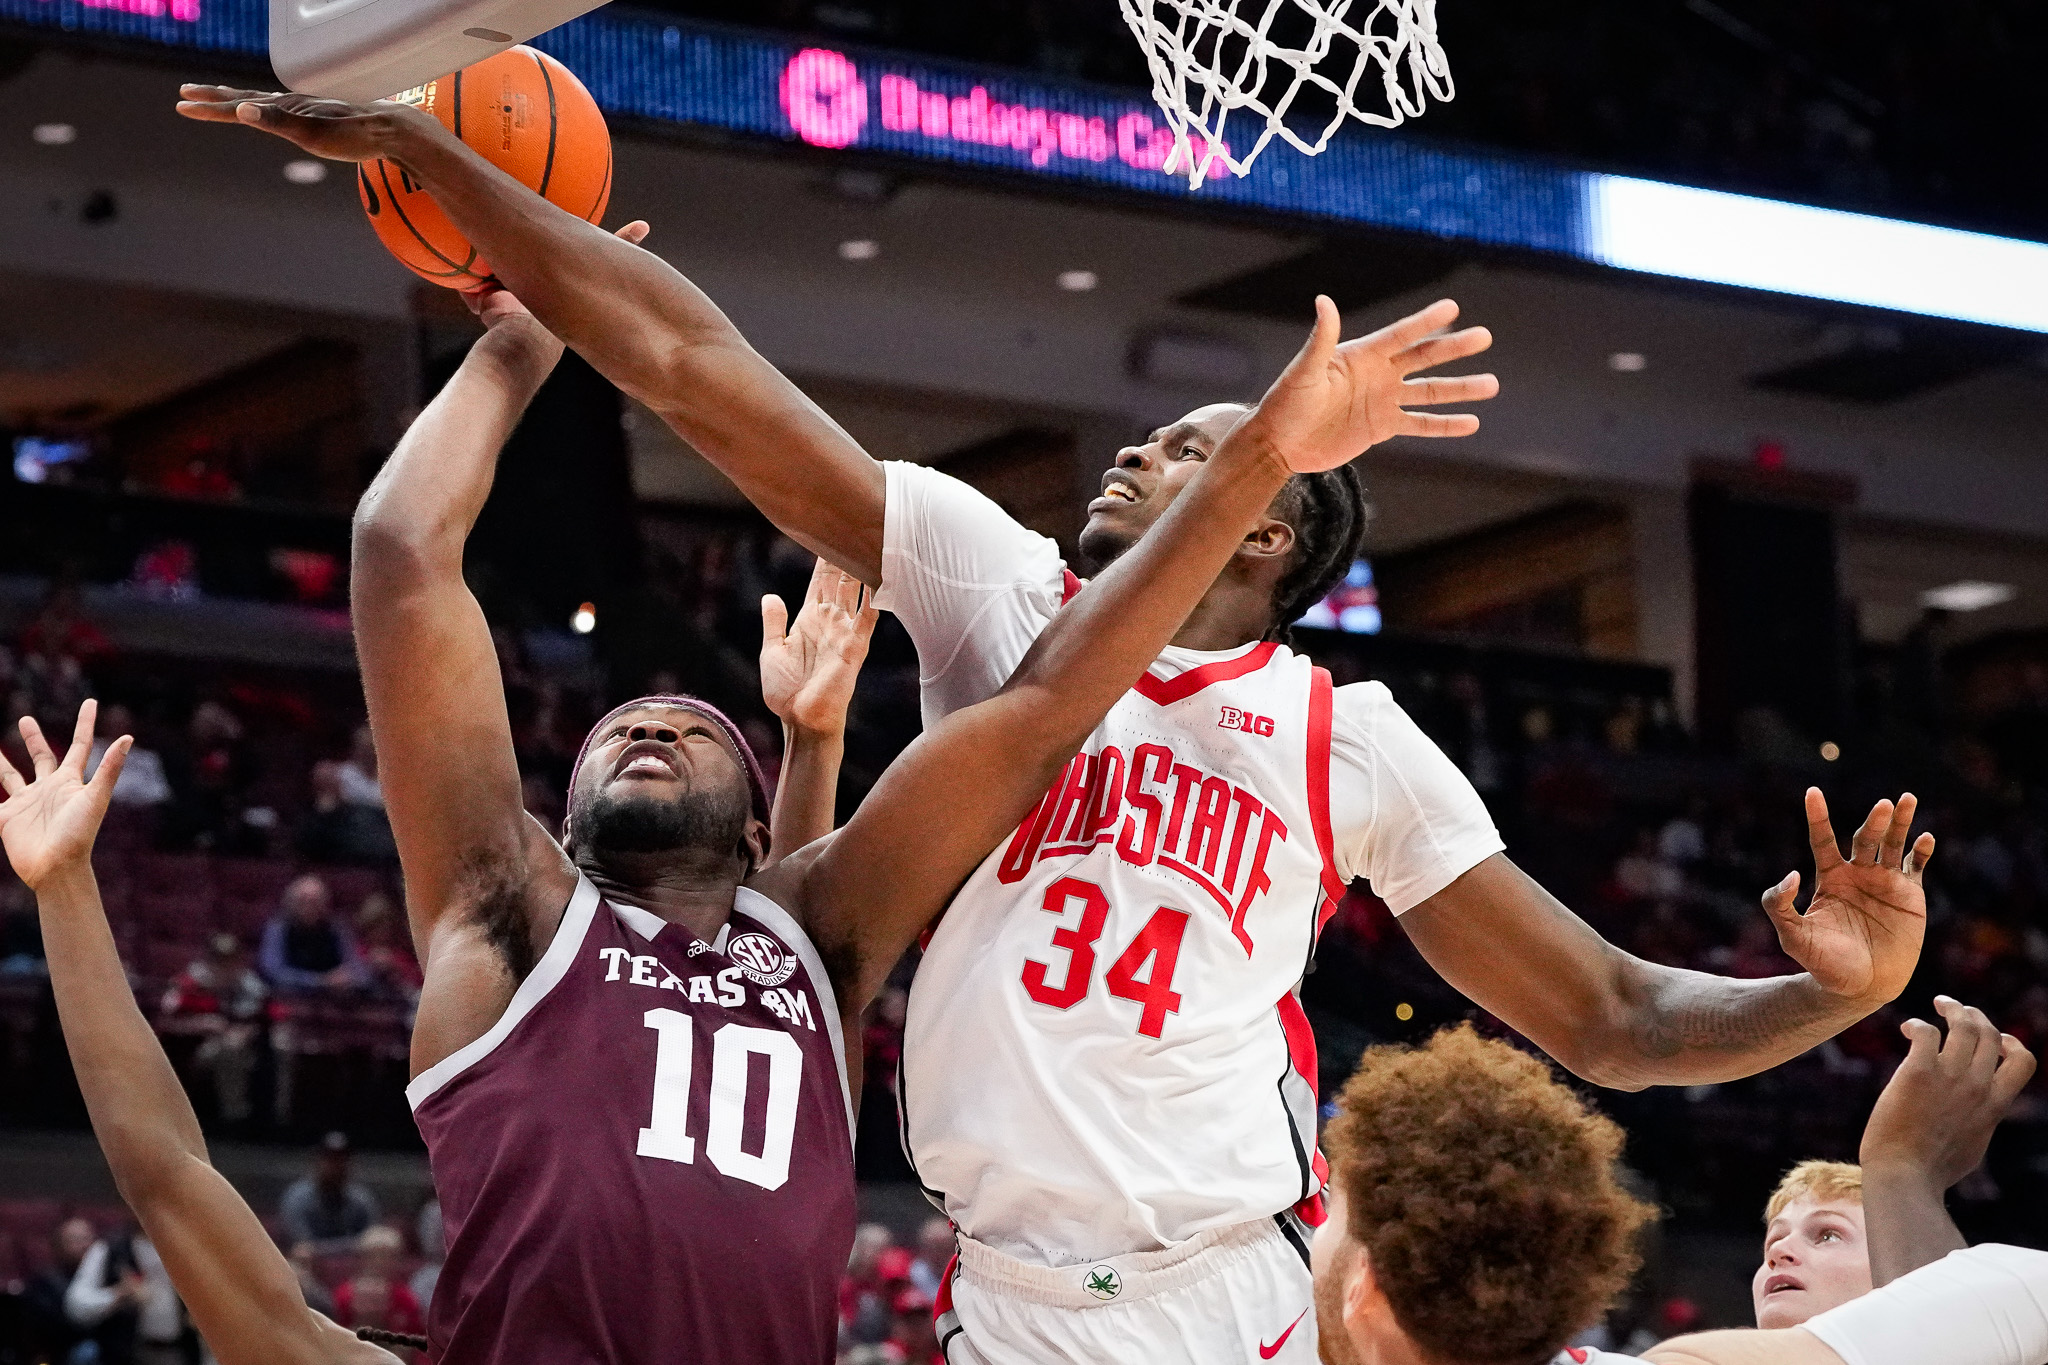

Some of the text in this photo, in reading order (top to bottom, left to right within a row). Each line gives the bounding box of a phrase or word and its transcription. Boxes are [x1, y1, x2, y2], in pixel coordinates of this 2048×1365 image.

[733, 936, 780, 973] SEC
[743, 965, 793, 986] GRADUATE
[1019, 875, 1191, 1041] 34
[636, 1007, 803, 1192] 10
